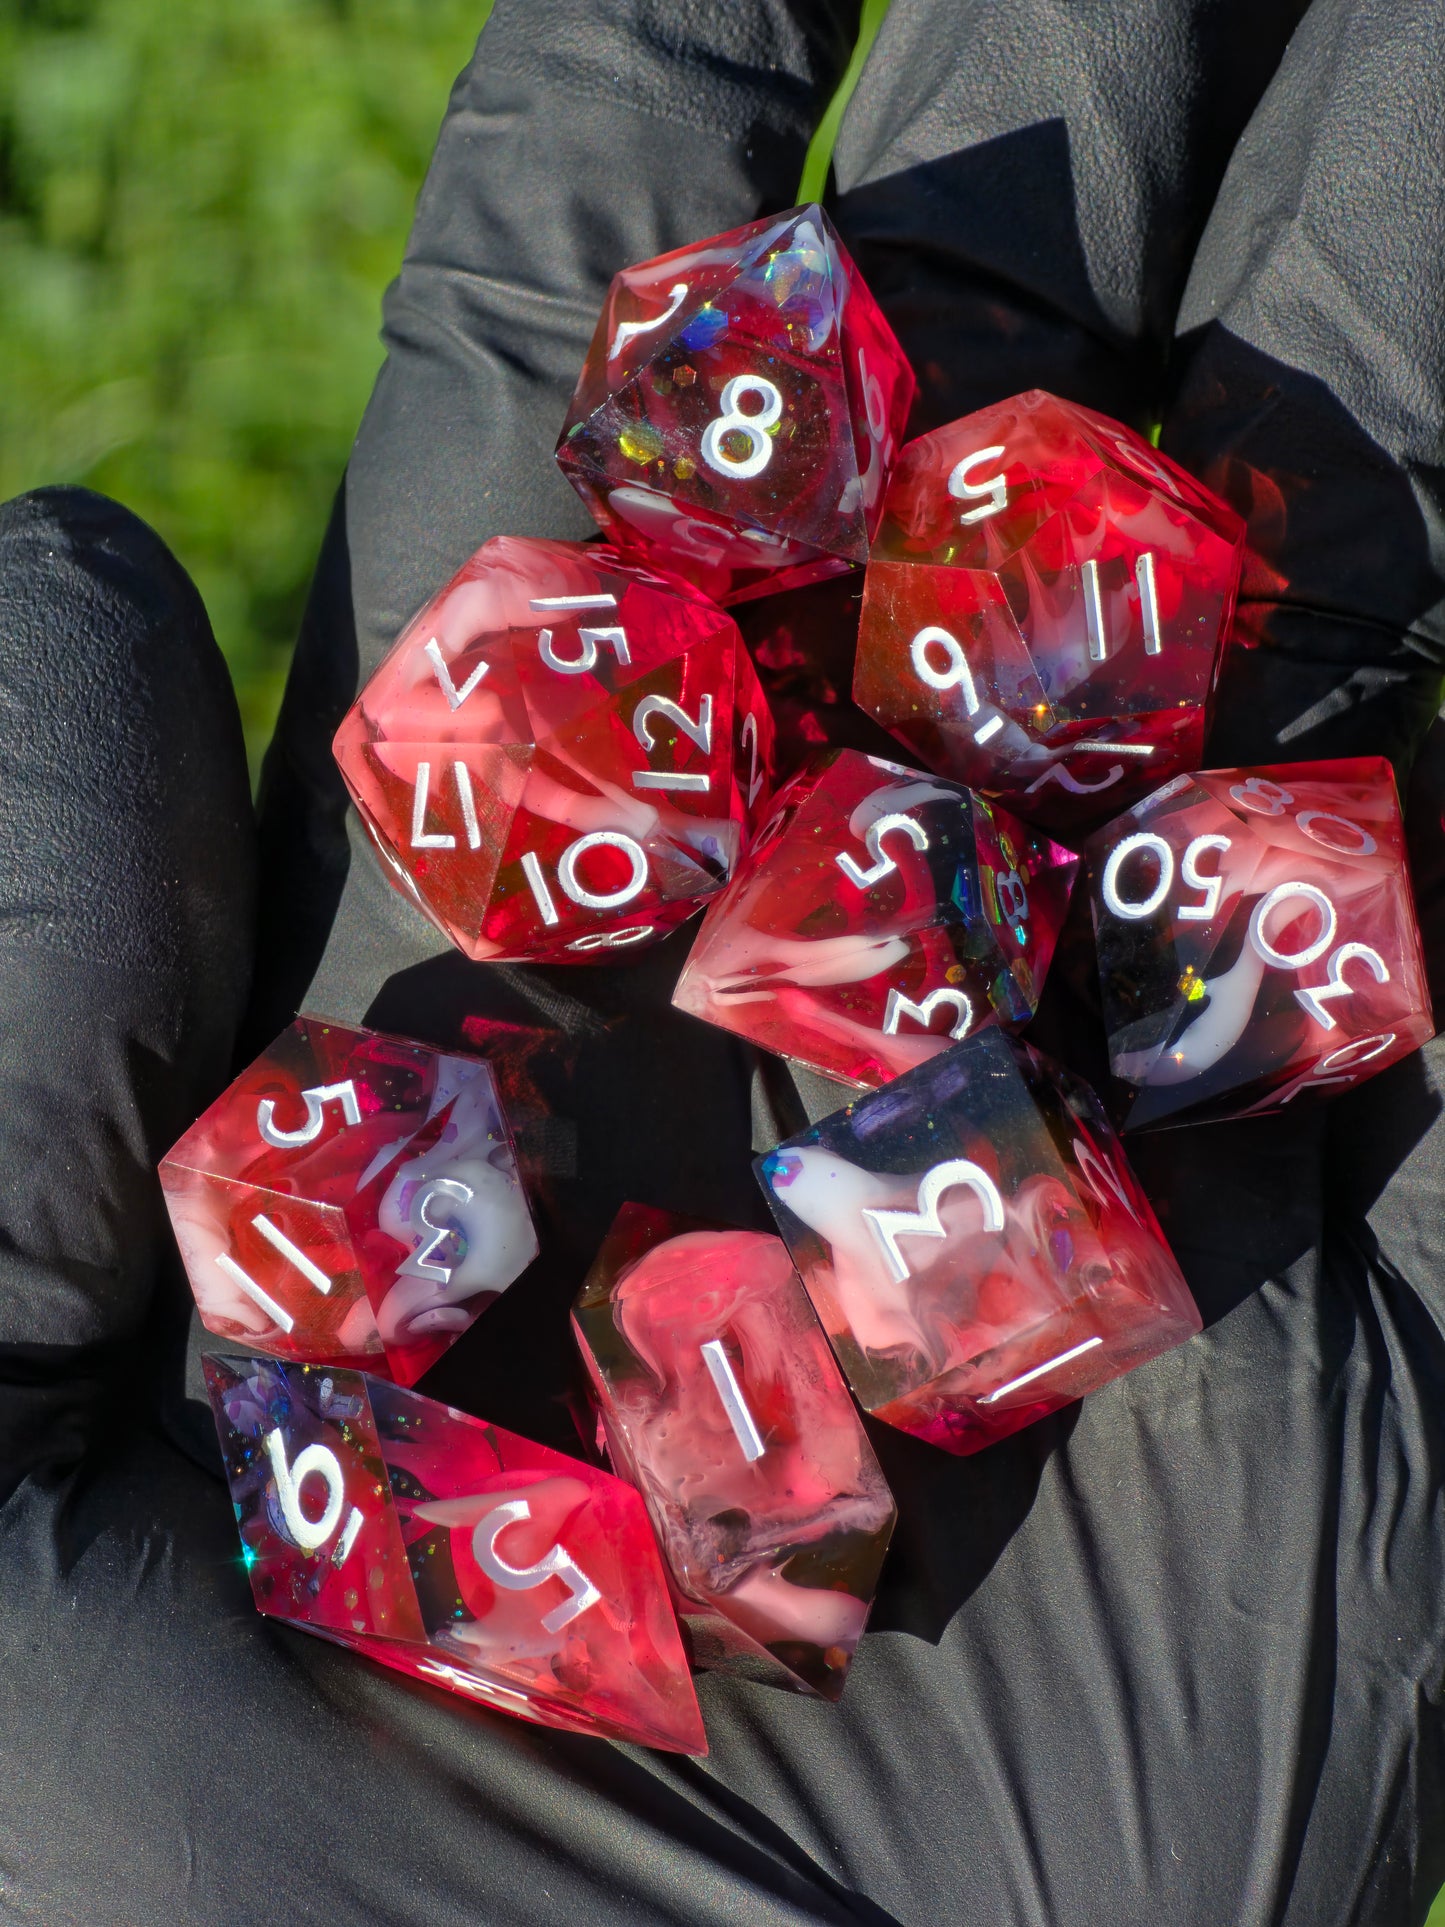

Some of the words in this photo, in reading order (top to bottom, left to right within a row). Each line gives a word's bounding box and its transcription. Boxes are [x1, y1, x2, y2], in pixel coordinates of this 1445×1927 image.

[701, 374, 783, 479] 8
[948, 446, 1008, 525] 5
[528, 593, 632, 674] 15
[1081, 552, 1162, 661] 11
[424, 637, 489, 712] 7
[911, 626, 980, 718] 9
[632, 693, 713, 791] 12
[411, 761, 481, 849] 17
[1229, 777, 1378, 855] 80
[521, 832, 648, 925] 10
[835, 813, 929, 890] 5
[1102, 833, 1232, 920] 50
[564, 925, 653, 951] 8
[997, 869, 1030, 928] 8
[1249, 882, 1390, 1031] 30
[882, 988, 974, 1040] 3
[257, 1079, 362, 1149] 5
[395, 1178, 475, 1285] 3
[862, 1159, 1004, 1283] 3
[214, 1213, 332, 1334] 11
[700, 1339, 766, 1463] 1
[976, 1336, 1103, 1404] 1
[267, 1427, 344, 1549] 6
[472, 1500, 601, 1634] 5
